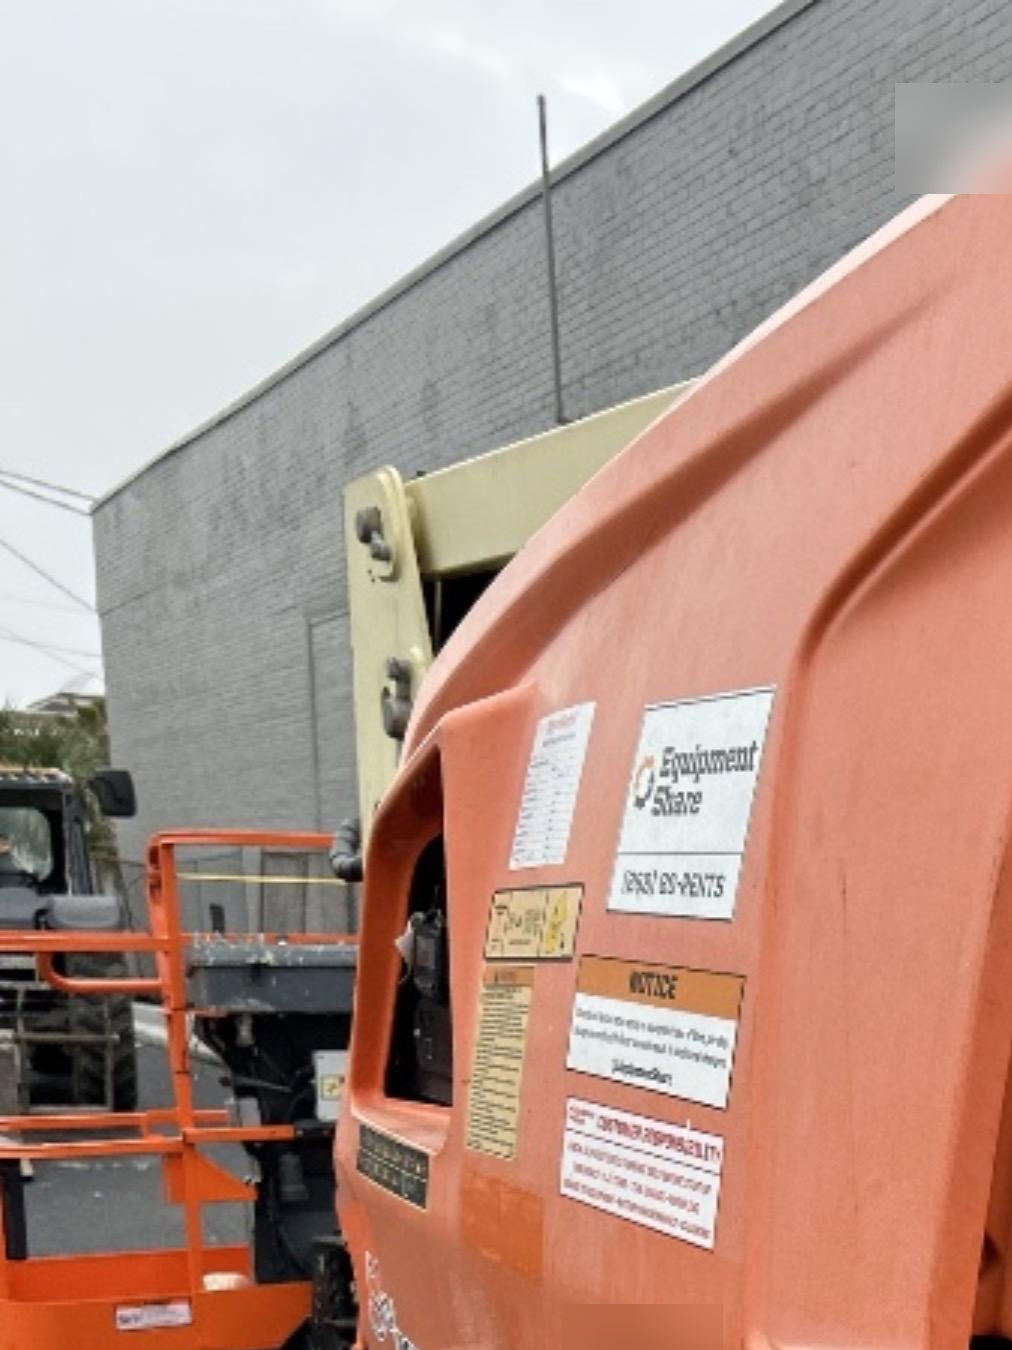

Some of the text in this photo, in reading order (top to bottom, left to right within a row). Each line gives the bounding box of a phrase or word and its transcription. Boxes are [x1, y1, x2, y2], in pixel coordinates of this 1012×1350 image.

[659, 740, 758, 783] Equipment
[651, 786, 702, 816] Share
[629, 971, 679, 1000] NOTICE
